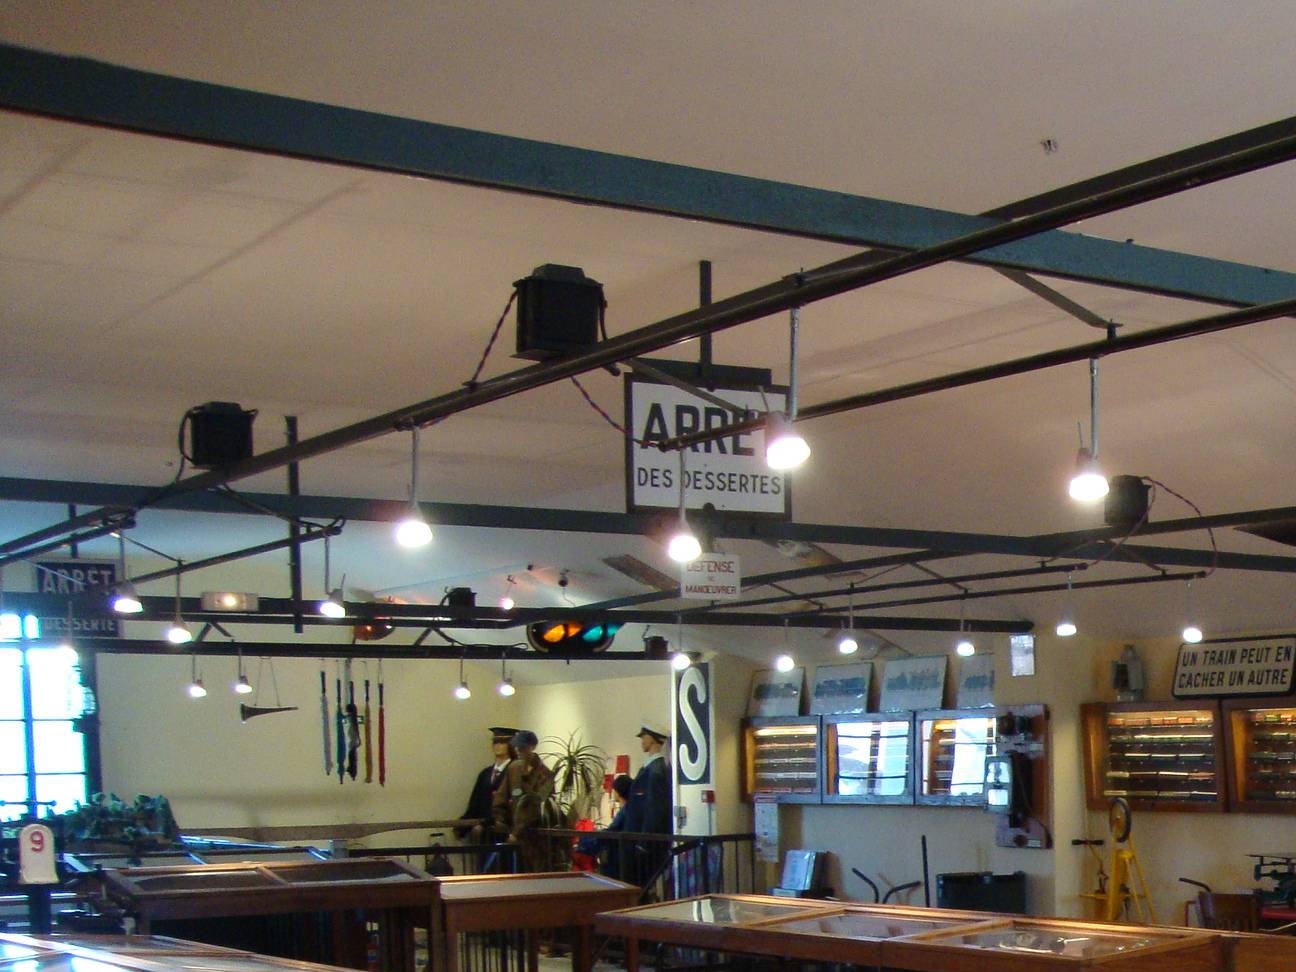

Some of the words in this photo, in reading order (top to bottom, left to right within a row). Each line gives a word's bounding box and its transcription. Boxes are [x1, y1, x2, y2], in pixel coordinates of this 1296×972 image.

[641, 402, 765, 456] ARRE
[637, 466, 673, 488] DES
[684, 470, 782, 495] DESSERTES
[1182, 651, 1198, 666] UN
[1202, 649, 1237, 665] TRAIN
[1240, 647, 1272, 664] PEUT
[1275, 646, 1292, 662] EN
[1178, 670, 1225, 688] CACHER
[1228, 670, 1244, 686] UN
[1247, 669, 1289, 685] AUTRE
[679, 667, 707, 780] S
[30, 831, 44, 852] 9
